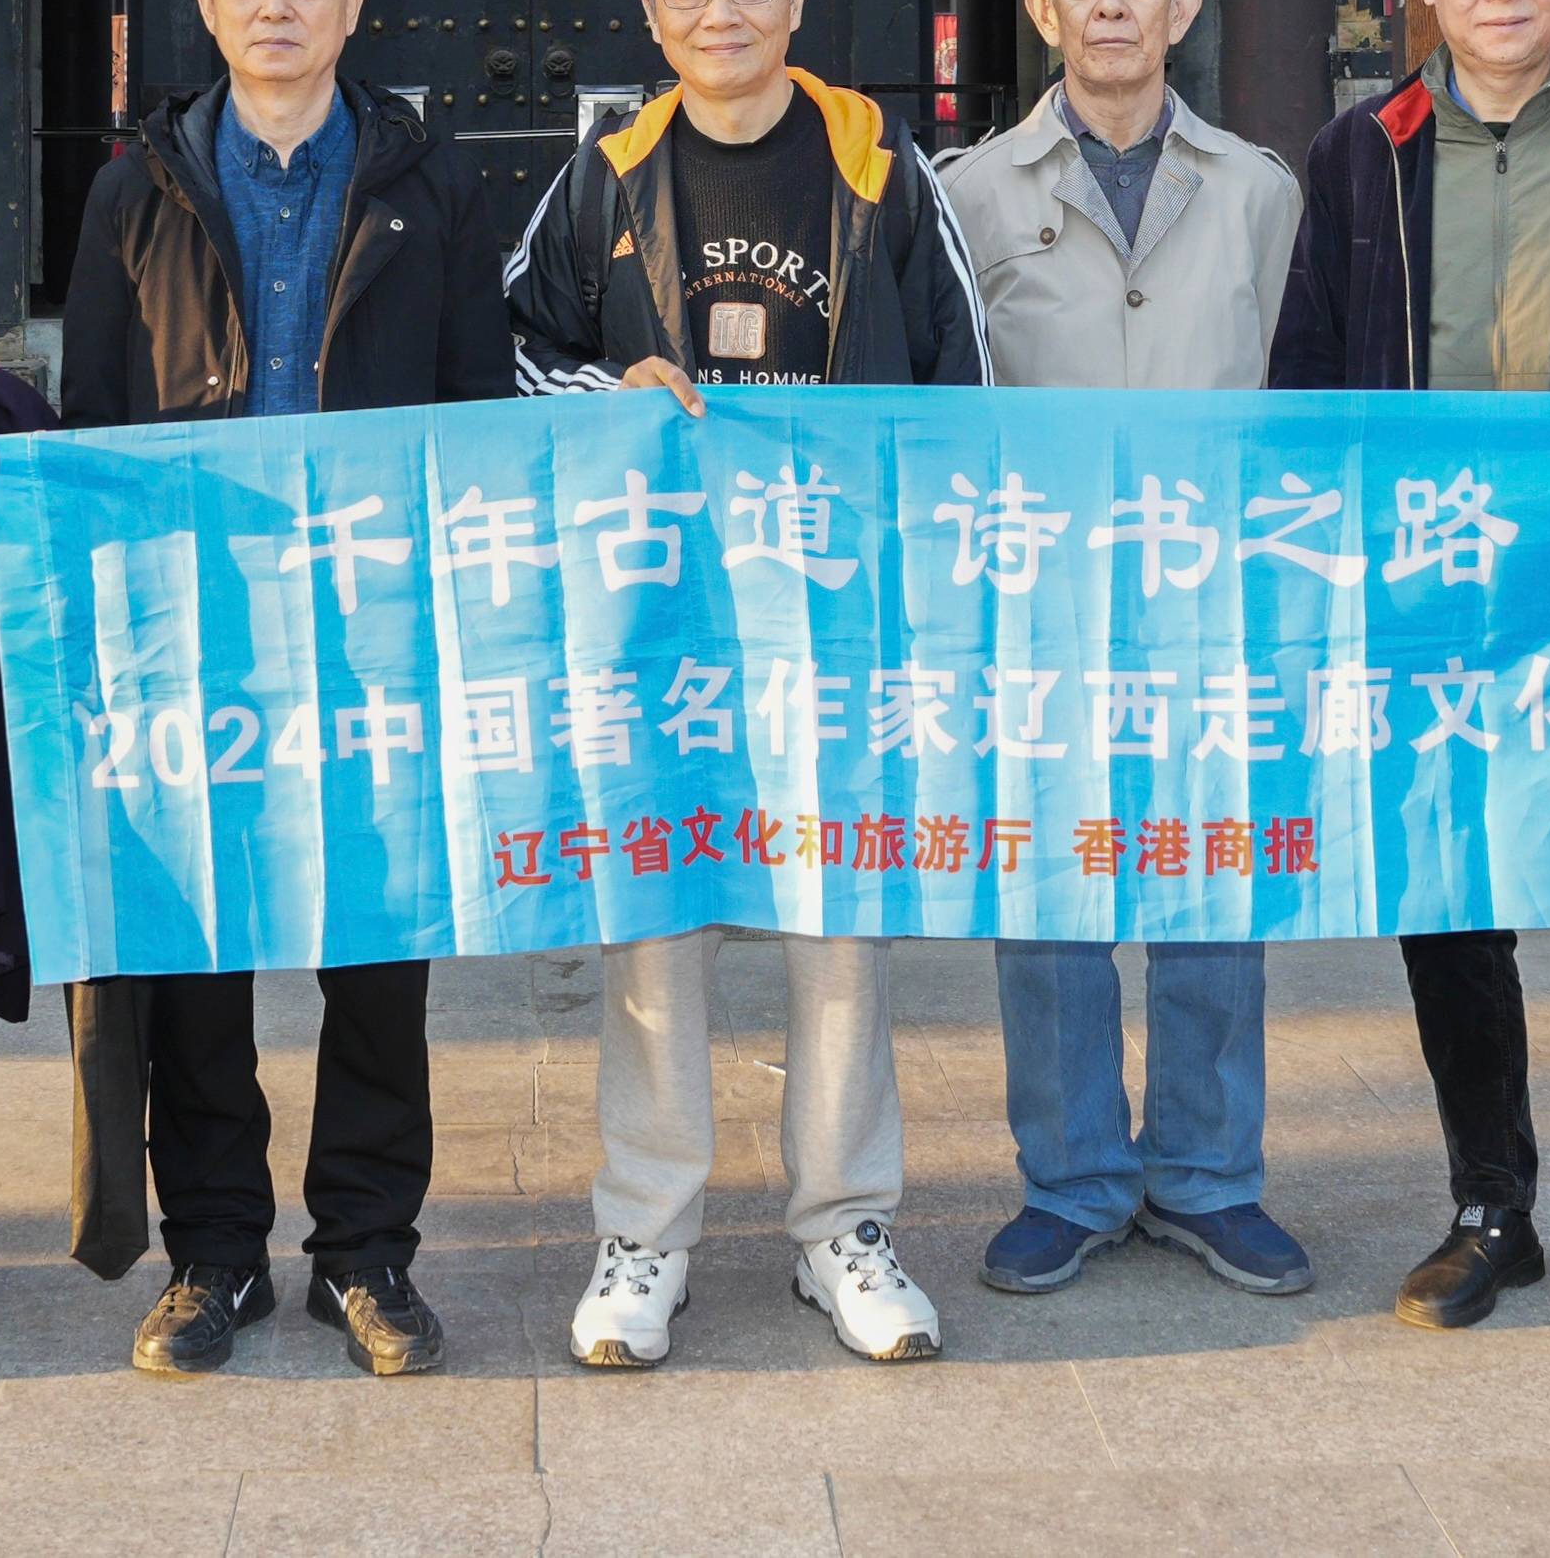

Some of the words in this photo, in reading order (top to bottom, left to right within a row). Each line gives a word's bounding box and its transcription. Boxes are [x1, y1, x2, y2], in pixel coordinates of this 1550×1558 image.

[684, 271, 805, 308] NTERNATIONAL
[279, 465, 858, 616] 千年古道
[933, 466, 1520, 598] 诗书之路
[494, 805, 1033, 889] 辽宁省文化和旅游厅
[1073, 815, 1321, 878] 香港商报
